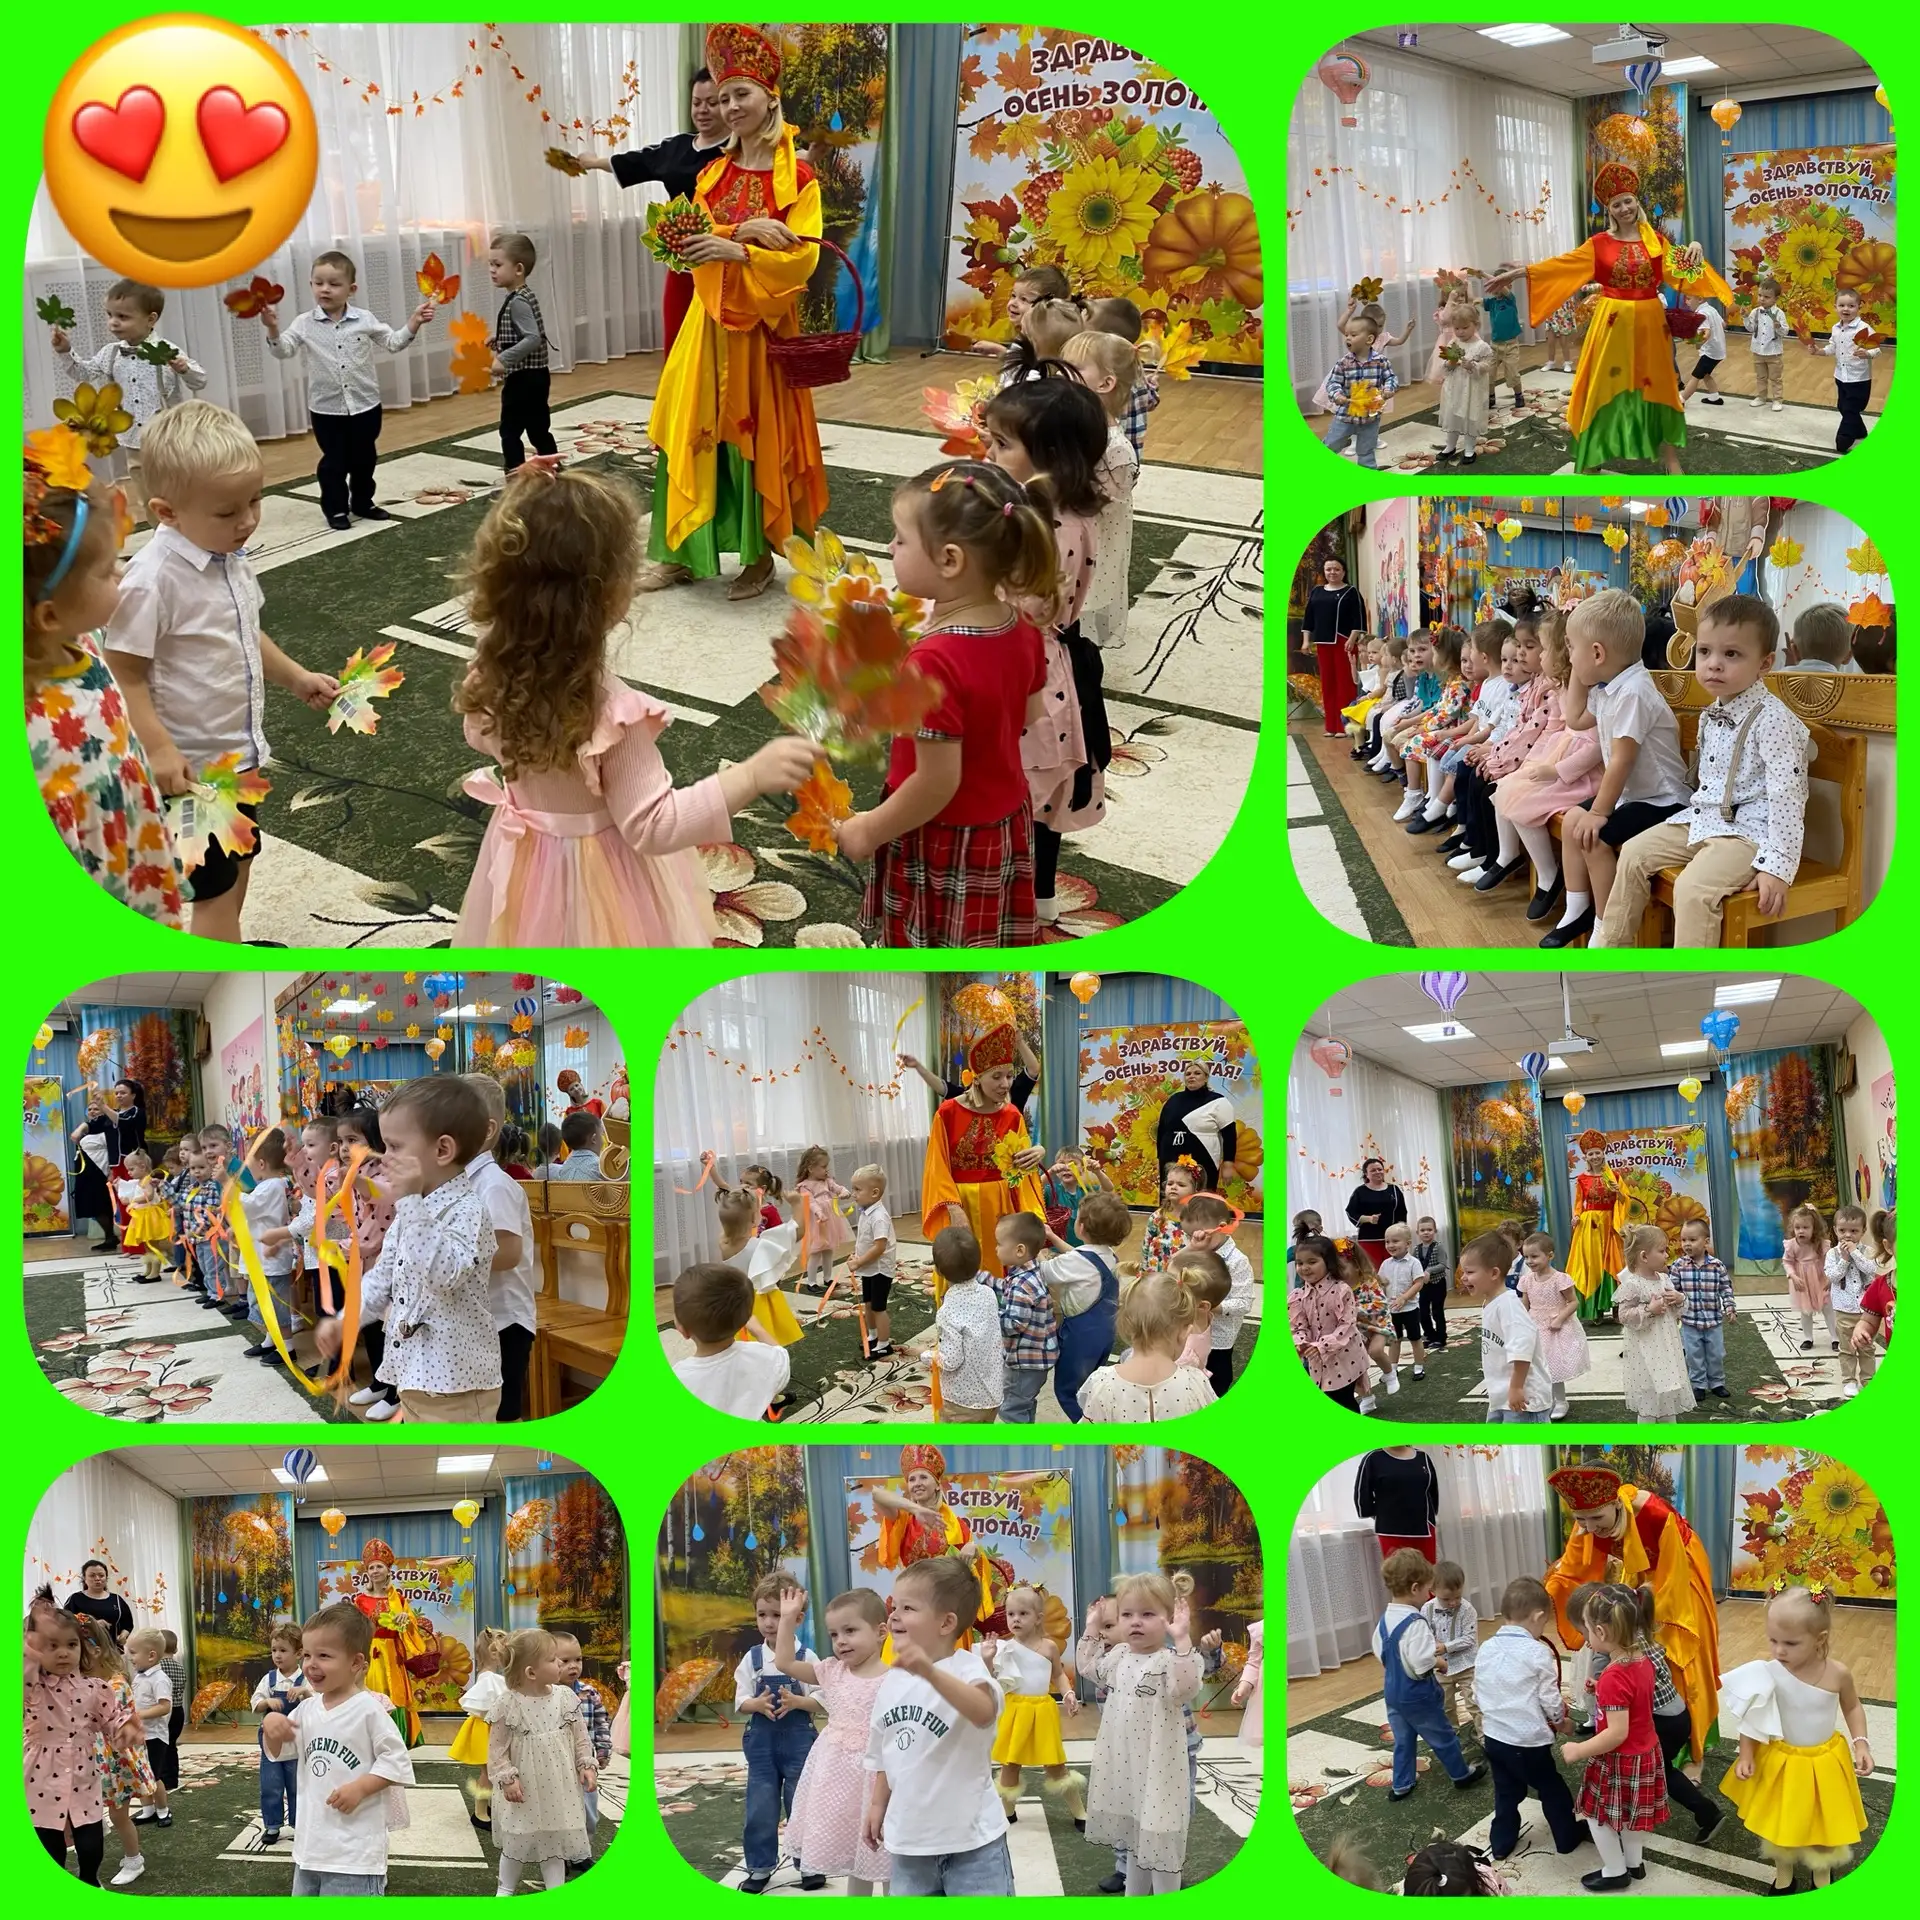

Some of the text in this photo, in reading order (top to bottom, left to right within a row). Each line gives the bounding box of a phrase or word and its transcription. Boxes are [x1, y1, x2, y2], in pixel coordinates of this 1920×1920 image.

[1032, 39, 1156, 74] ЗДРАВ
[1003, 79, 1208, 118] ОСЕНЬ ЗОЛОТ
[1763, 160, 1875, 182] ЗДРАВСТВУЙ,
[1749, 183, 1891, 205] ОСЕНЬ ЗОЛОТАЯ!
[1118, 1036, 1230, 1058] ЗДРАВСТВУЙ,
[1104, 1060, 1243, 1082] ОСЕНЬ ЗОЛТАЯ!
[1604, 1137, 1676, 1155] ДРАВСТВУЙ,
[1626, 1155, 1687, 1168] ЗОЛОТАЯ!
[948, 1490, 1024, 1513] ВСТВУЙ,
[882, 1704, 950, 1739] EKEND FUN
[336, 1745, 361, 1771] FUN
